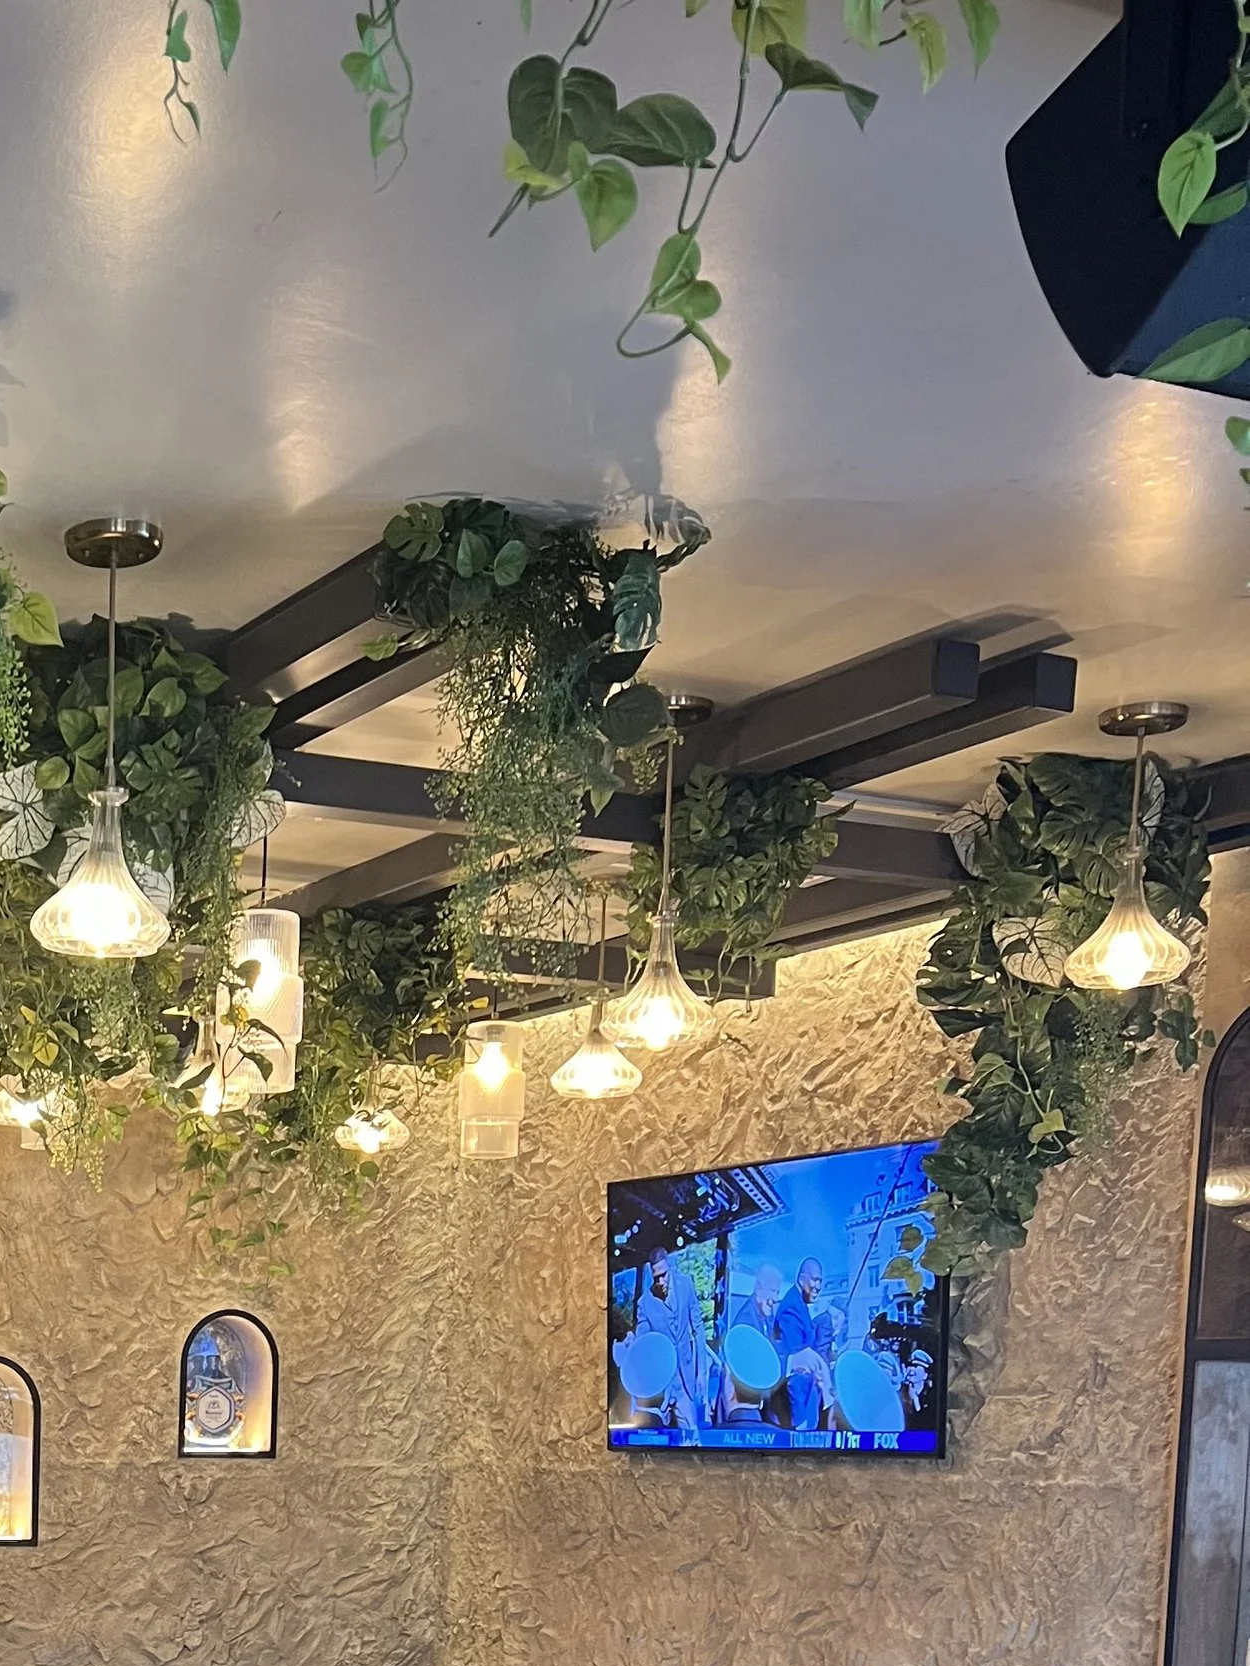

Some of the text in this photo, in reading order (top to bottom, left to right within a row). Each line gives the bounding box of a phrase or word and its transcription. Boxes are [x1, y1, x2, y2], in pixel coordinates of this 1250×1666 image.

[723, 1433, 743, 1444] ALL
[745, 1433, 776, 1445] NEW
[873, 1433, 900, 1449] FOX
